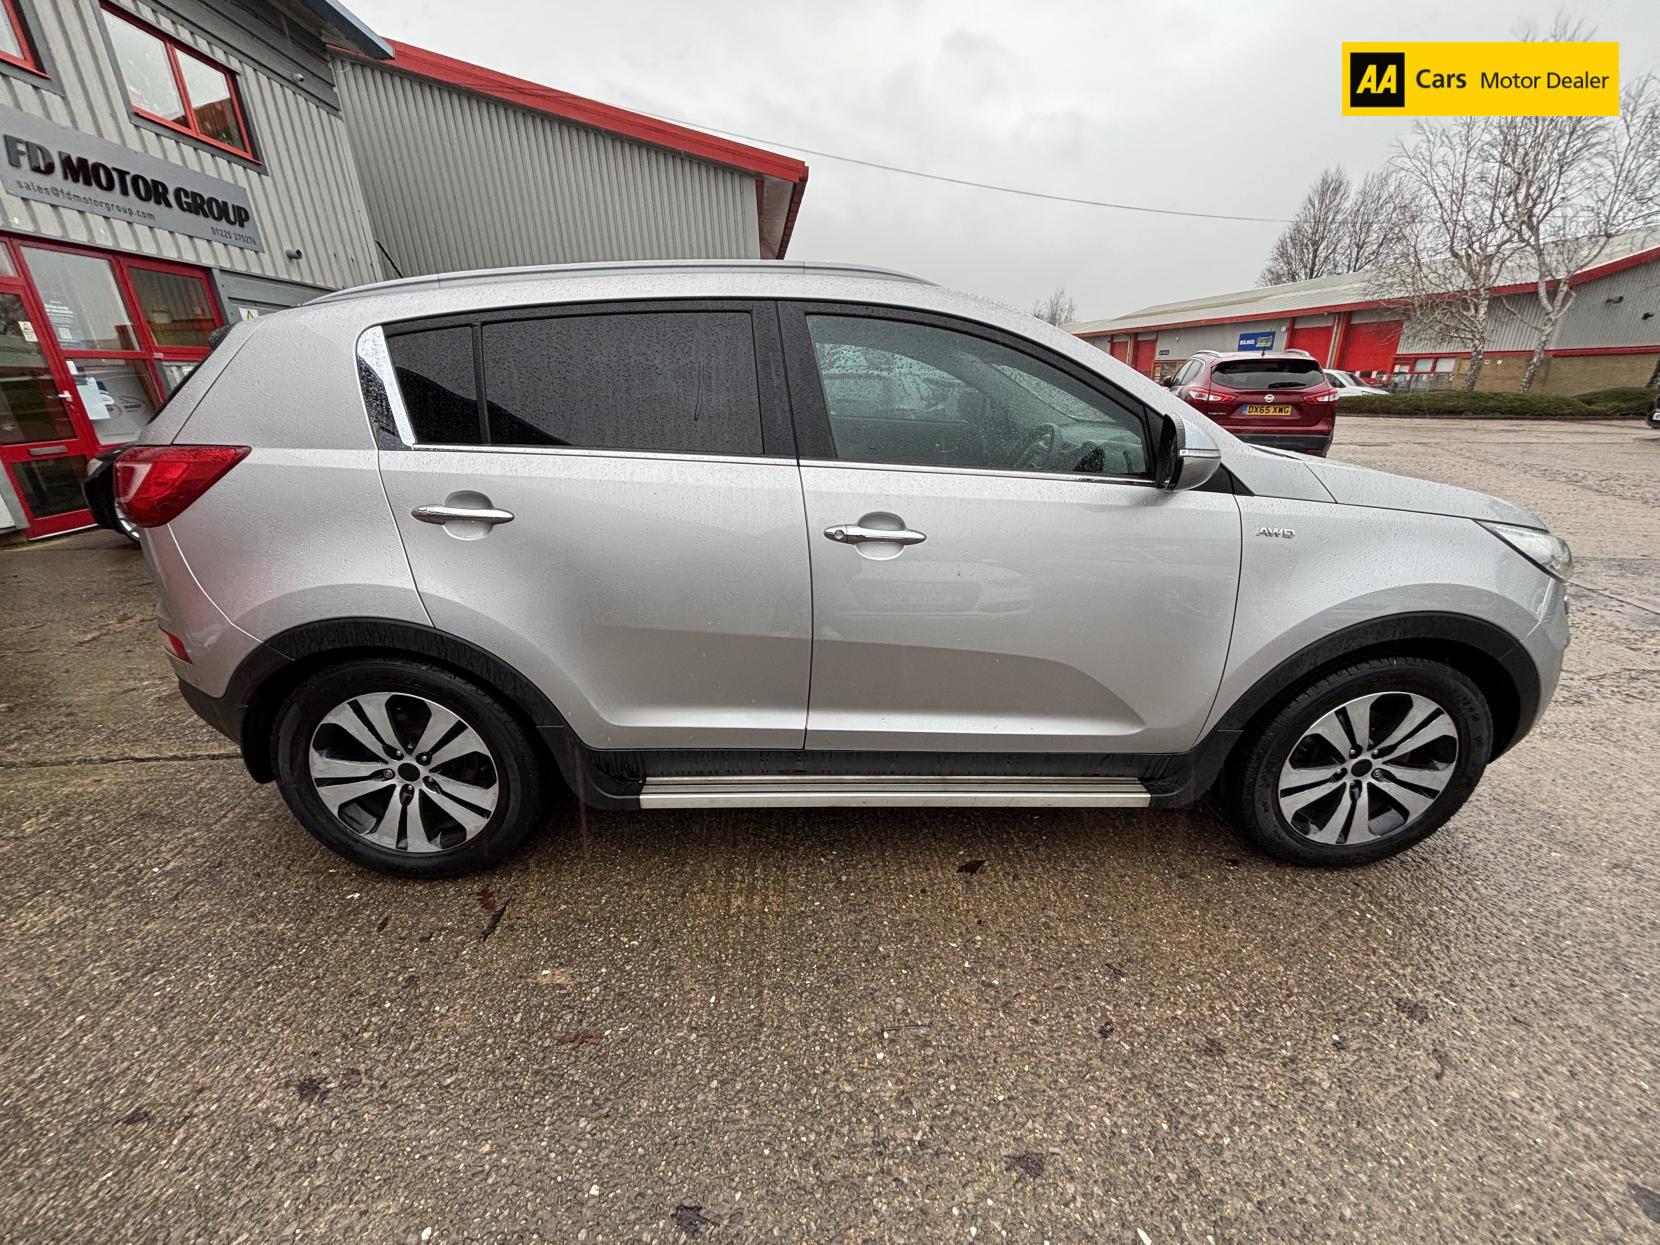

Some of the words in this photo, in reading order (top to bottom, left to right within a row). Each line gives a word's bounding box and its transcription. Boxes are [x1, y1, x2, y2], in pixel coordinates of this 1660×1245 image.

[3, 134, 56, 176] FD
[58, 150, 174, 209] MOTOR
[173, 187, 250, 228] GROUP
[16, 180, 156, 221] sales@fdmotorgroup.com
[1247, 405, 1271, 414] DX65
[1255, 527, 1296, 539] AWD
